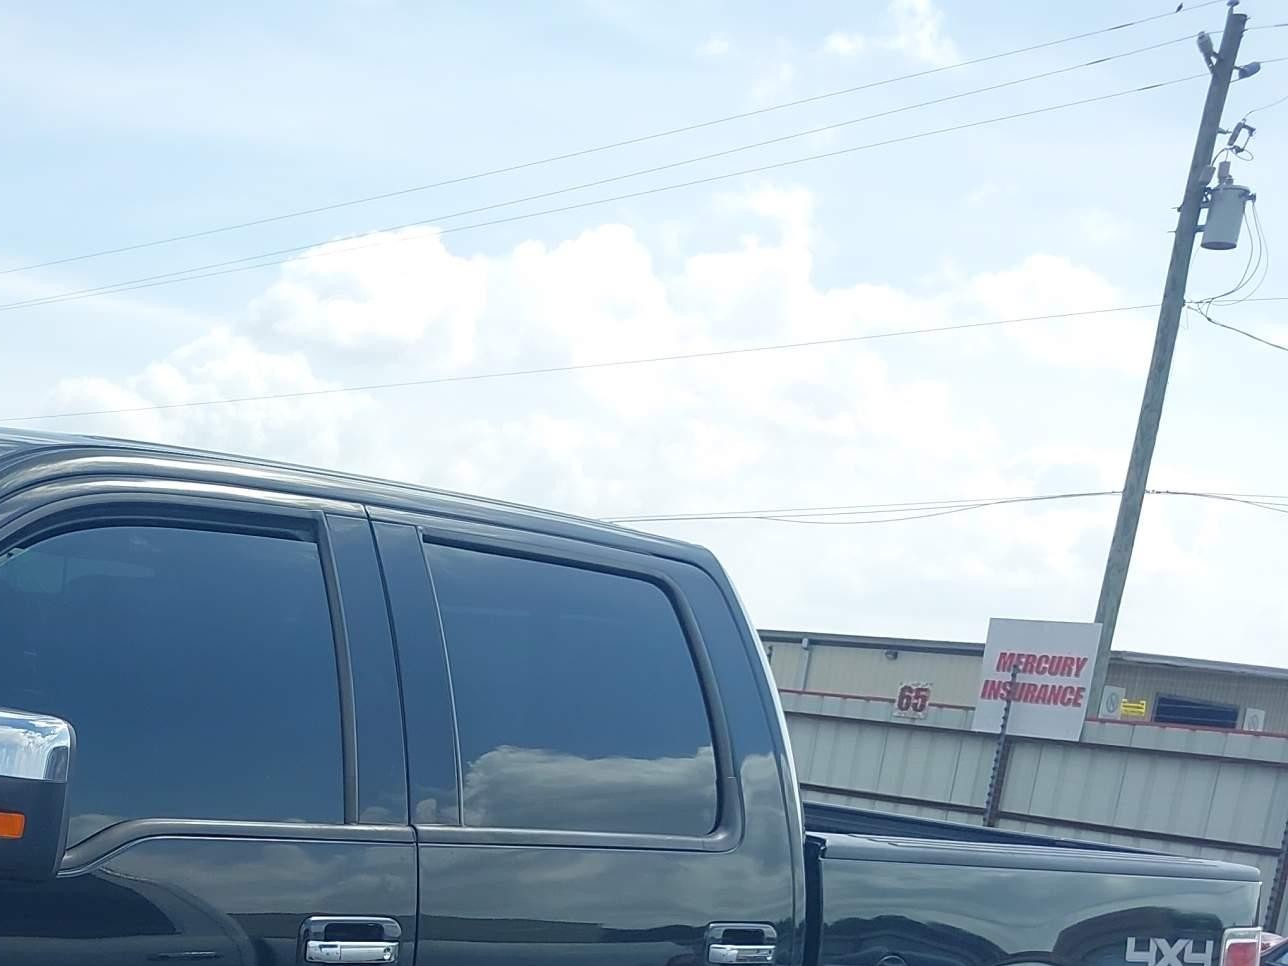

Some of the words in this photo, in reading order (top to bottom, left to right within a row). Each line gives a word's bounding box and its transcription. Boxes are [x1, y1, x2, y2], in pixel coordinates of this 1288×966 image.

[996, 652, 1088, 678] MERCURY
[898, 685, 930, 713] 65
[980, 679, 1086, 708] INSURANCE
